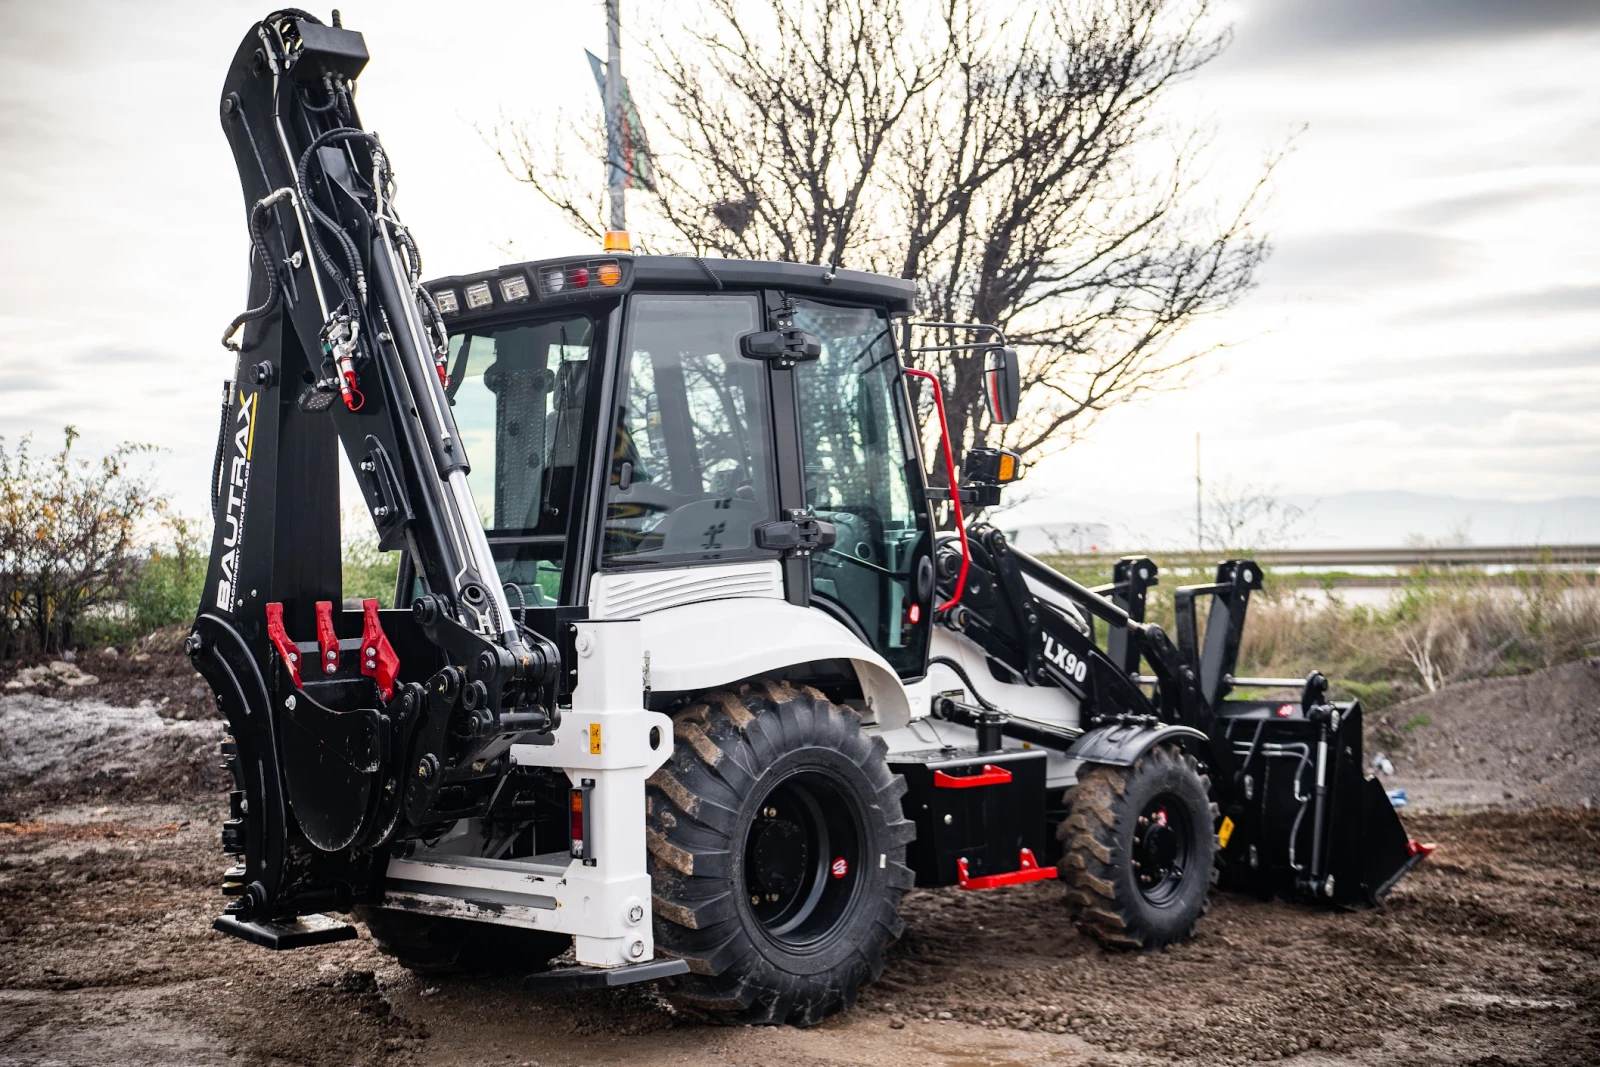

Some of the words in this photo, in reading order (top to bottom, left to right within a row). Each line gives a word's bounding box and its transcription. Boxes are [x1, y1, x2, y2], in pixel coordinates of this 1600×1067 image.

[216, 389, 254, 612] BAUTRAX
[229, 547, 240, 613] MACHINERY
[237, 461, 250, 543] MARKETPLACE
[1042, 631, 1088, 683] LX90
